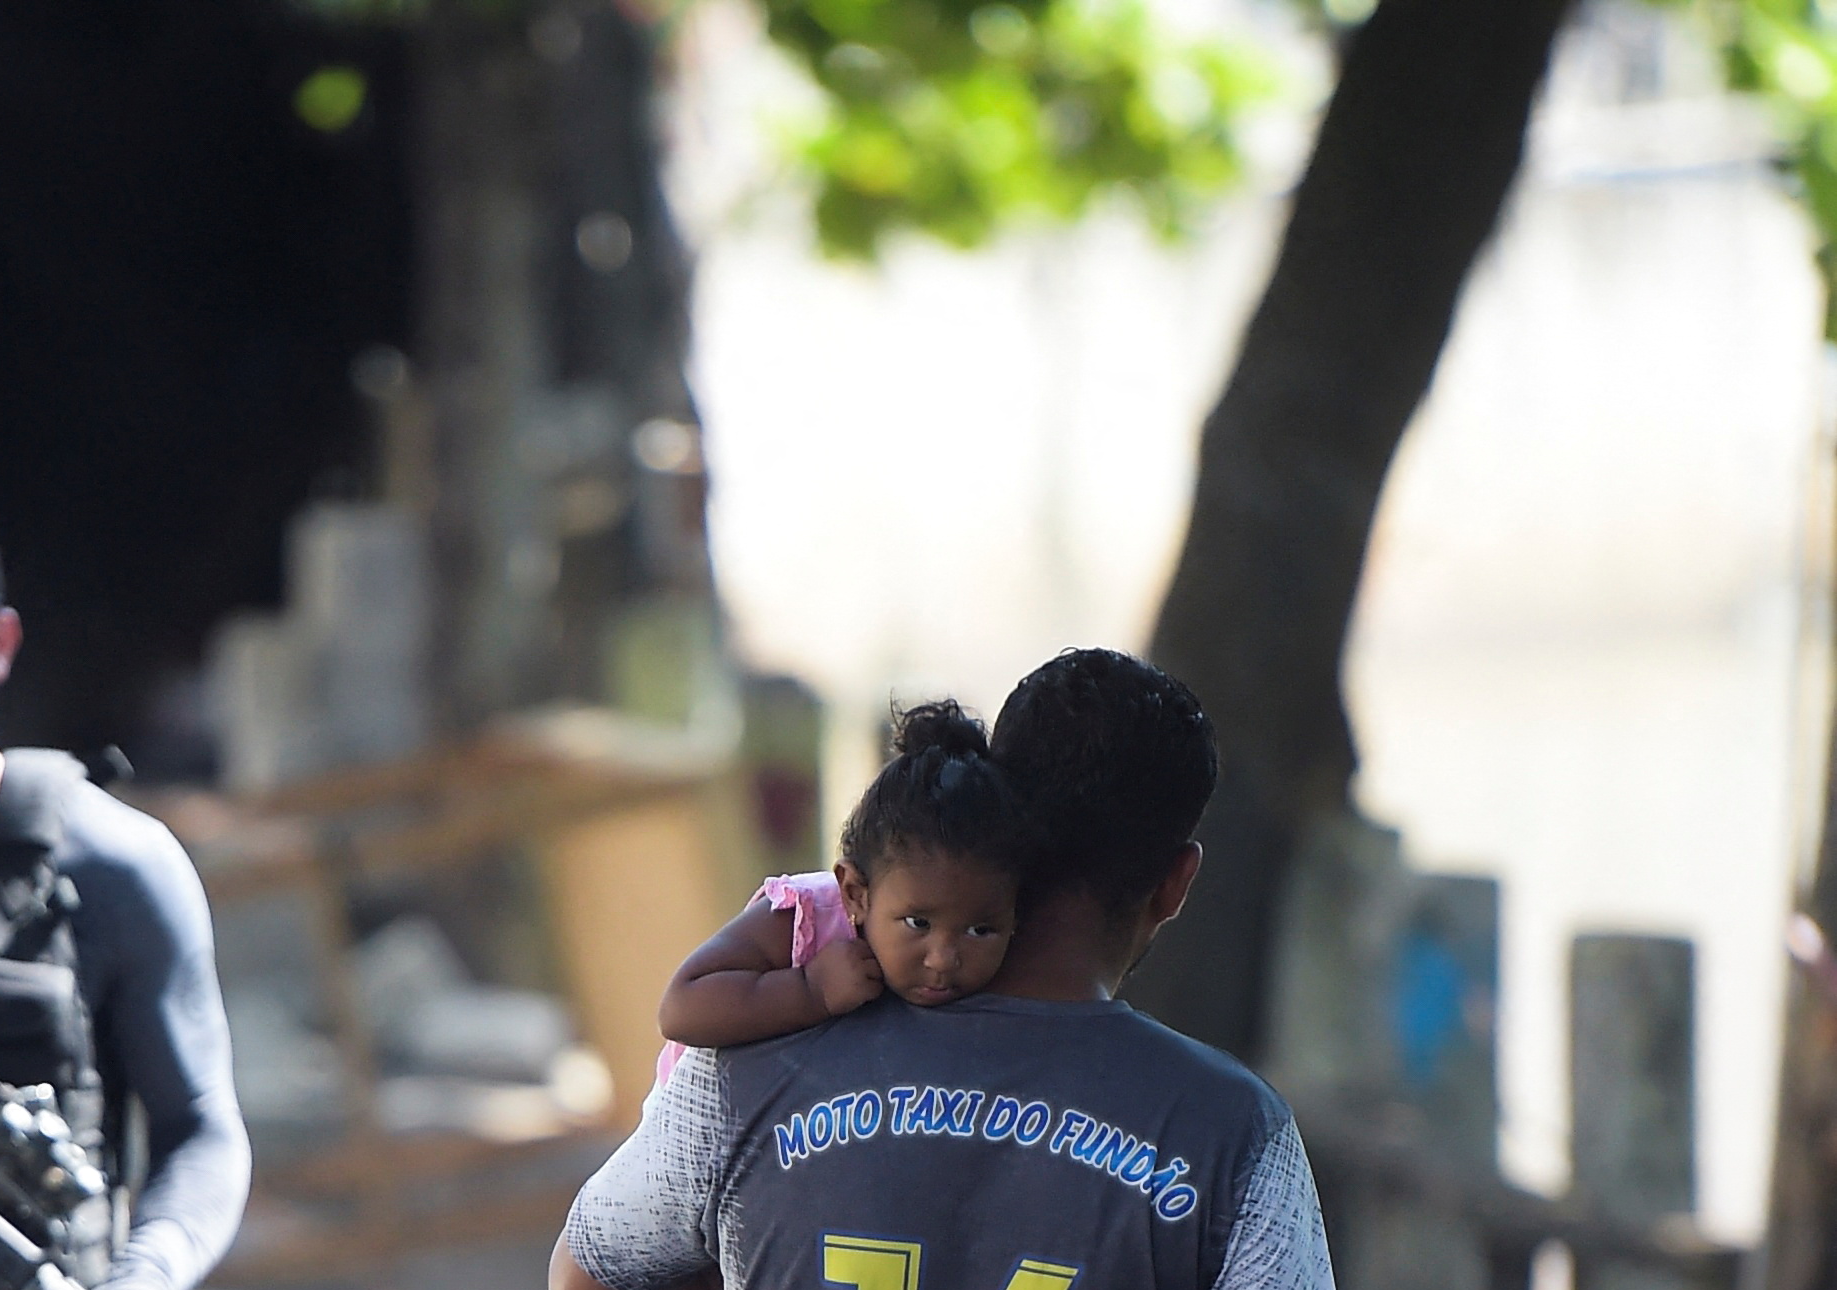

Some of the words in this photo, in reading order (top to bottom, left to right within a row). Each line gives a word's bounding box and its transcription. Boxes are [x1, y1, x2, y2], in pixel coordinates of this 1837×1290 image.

[774, 1090, 882, 1169] MOTO
[889, 1086, 984, 1136] TAXI
[983, 1095, 1050, 1146] DO
[1050, 1111, 1197, 1221] FUNDÃO
